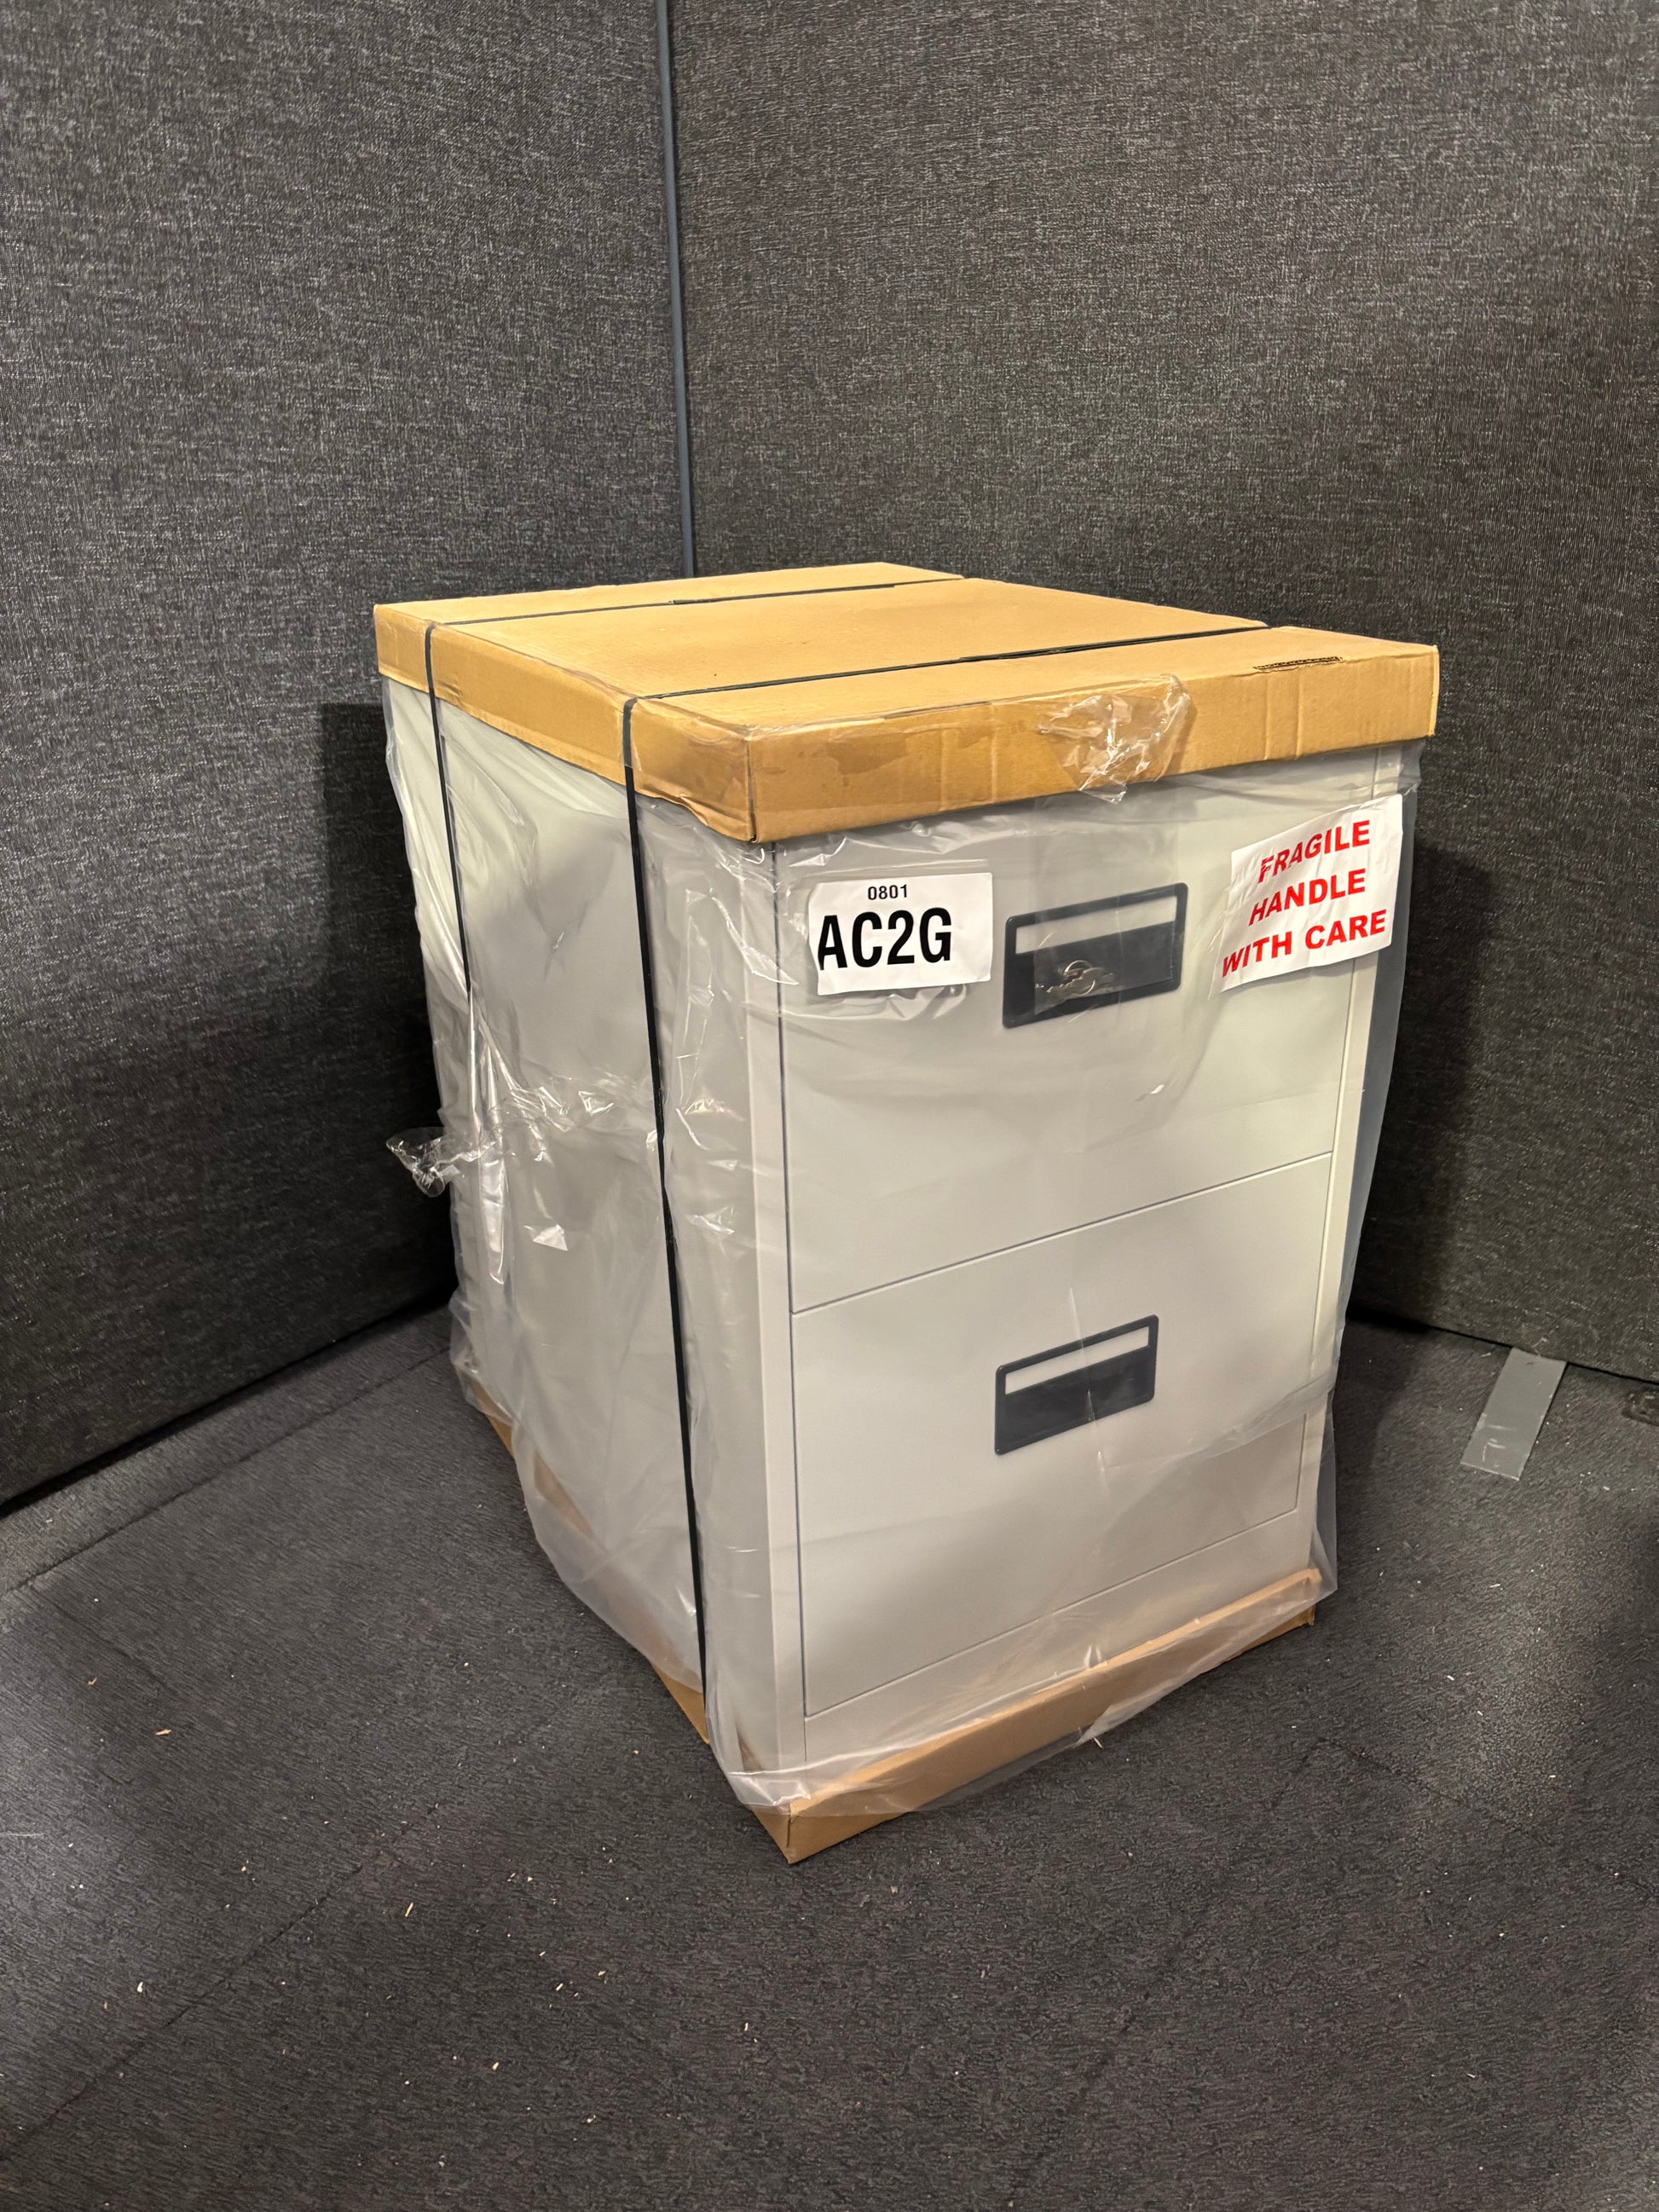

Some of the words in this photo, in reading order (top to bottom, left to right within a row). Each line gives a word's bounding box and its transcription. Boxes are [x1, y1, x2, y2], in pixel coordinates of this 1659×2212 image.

[1257, 819, 1370, 884] FRAGILE
[867, 884, 908, 900] 0801
[1248, 868, 1366, 927] HANDLE
[818, 907, 952, 971] AC2G
[1222, 931, 1292, 979] WITH
[1304, 909, 1387, 950] CARE
